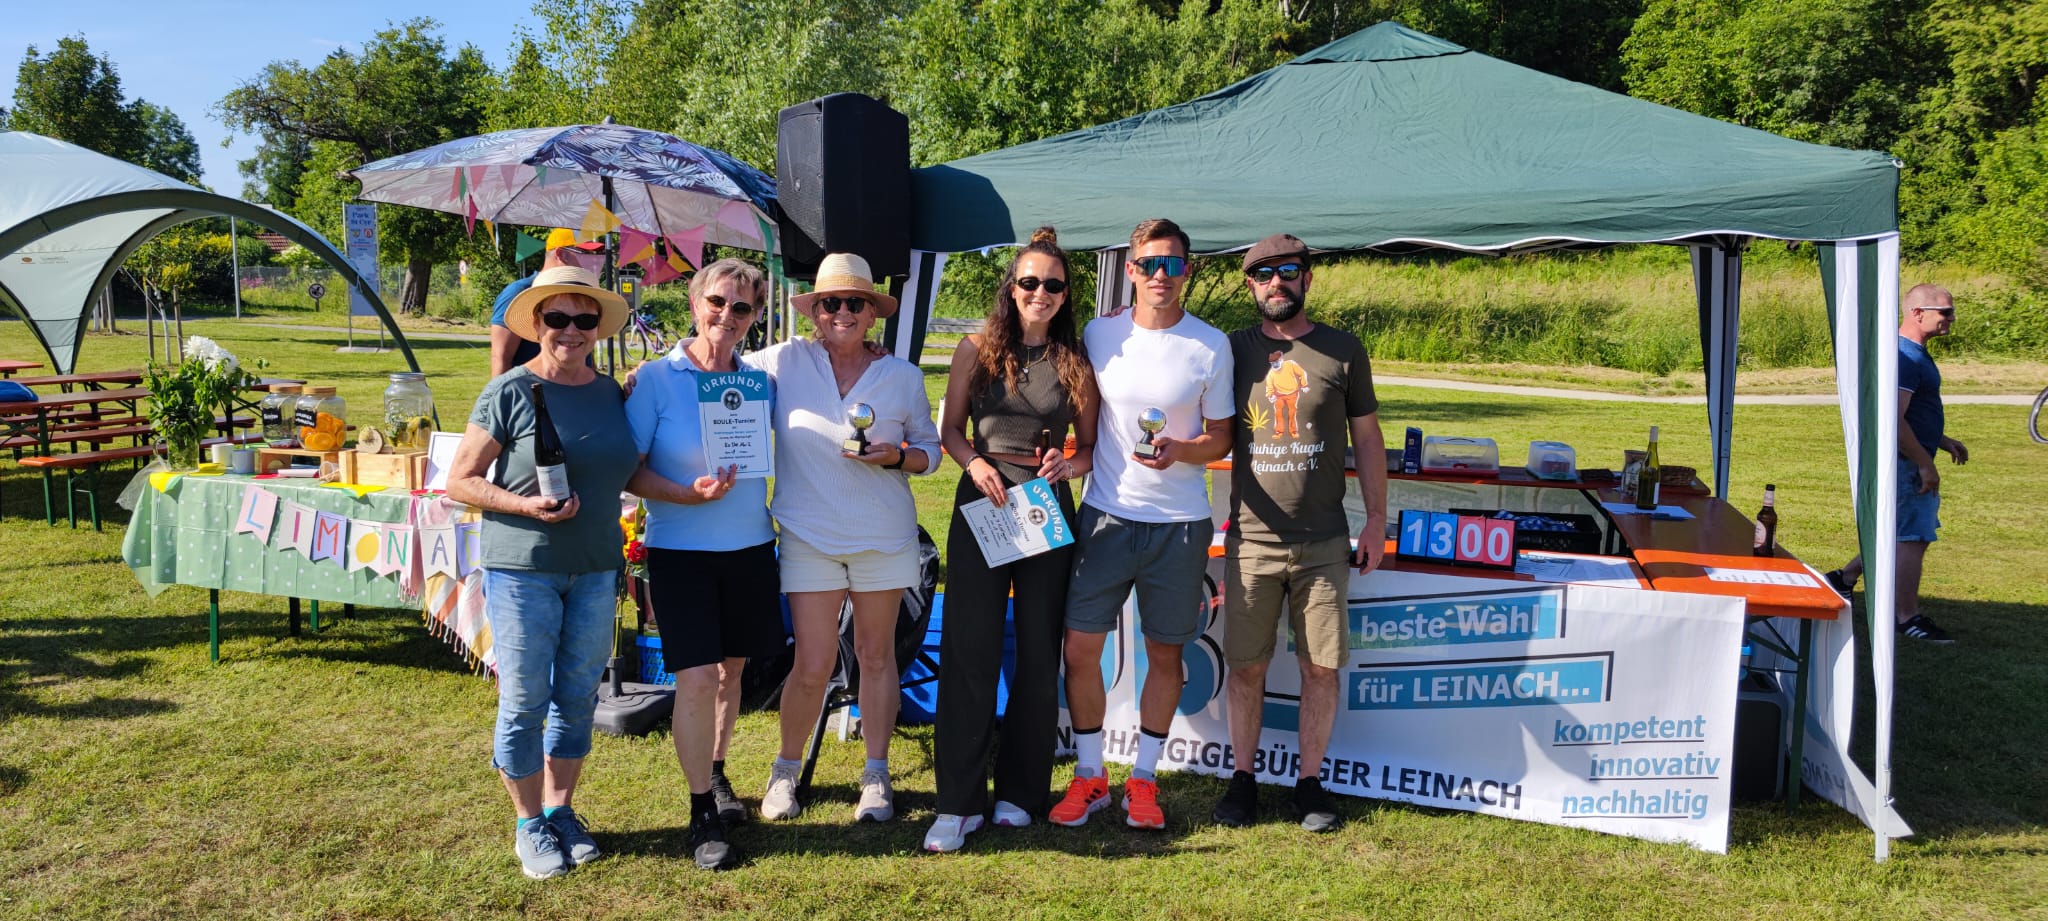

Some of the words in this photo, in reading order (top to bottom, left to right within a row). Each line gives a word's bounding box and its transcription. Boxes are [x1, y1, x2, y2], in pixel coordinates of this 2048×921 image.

[702, 375, 762, 393] URKUNDE
[1248, 442, 1288, 458] Ruhige
[1290, 441, 1325, 457] Kugel
[1251, 460, 1295, 475] Leinach
[1032, 485, 1064, 542] URKUNDE
[1360, 613, 1446, 643] beste
[1456, 604, 1541, 636] Wahl
[1358, 677, 1404, 704] für
[1413, 671, 1590, 702] LEINACH...
[1553, 715, 1706, 745] kompetent
[1589, 751, 1721, 777] innovativ
[1381, 765, 1522, 810] LEINACH
[1561, 789, 1709, 820] nachhaltig
